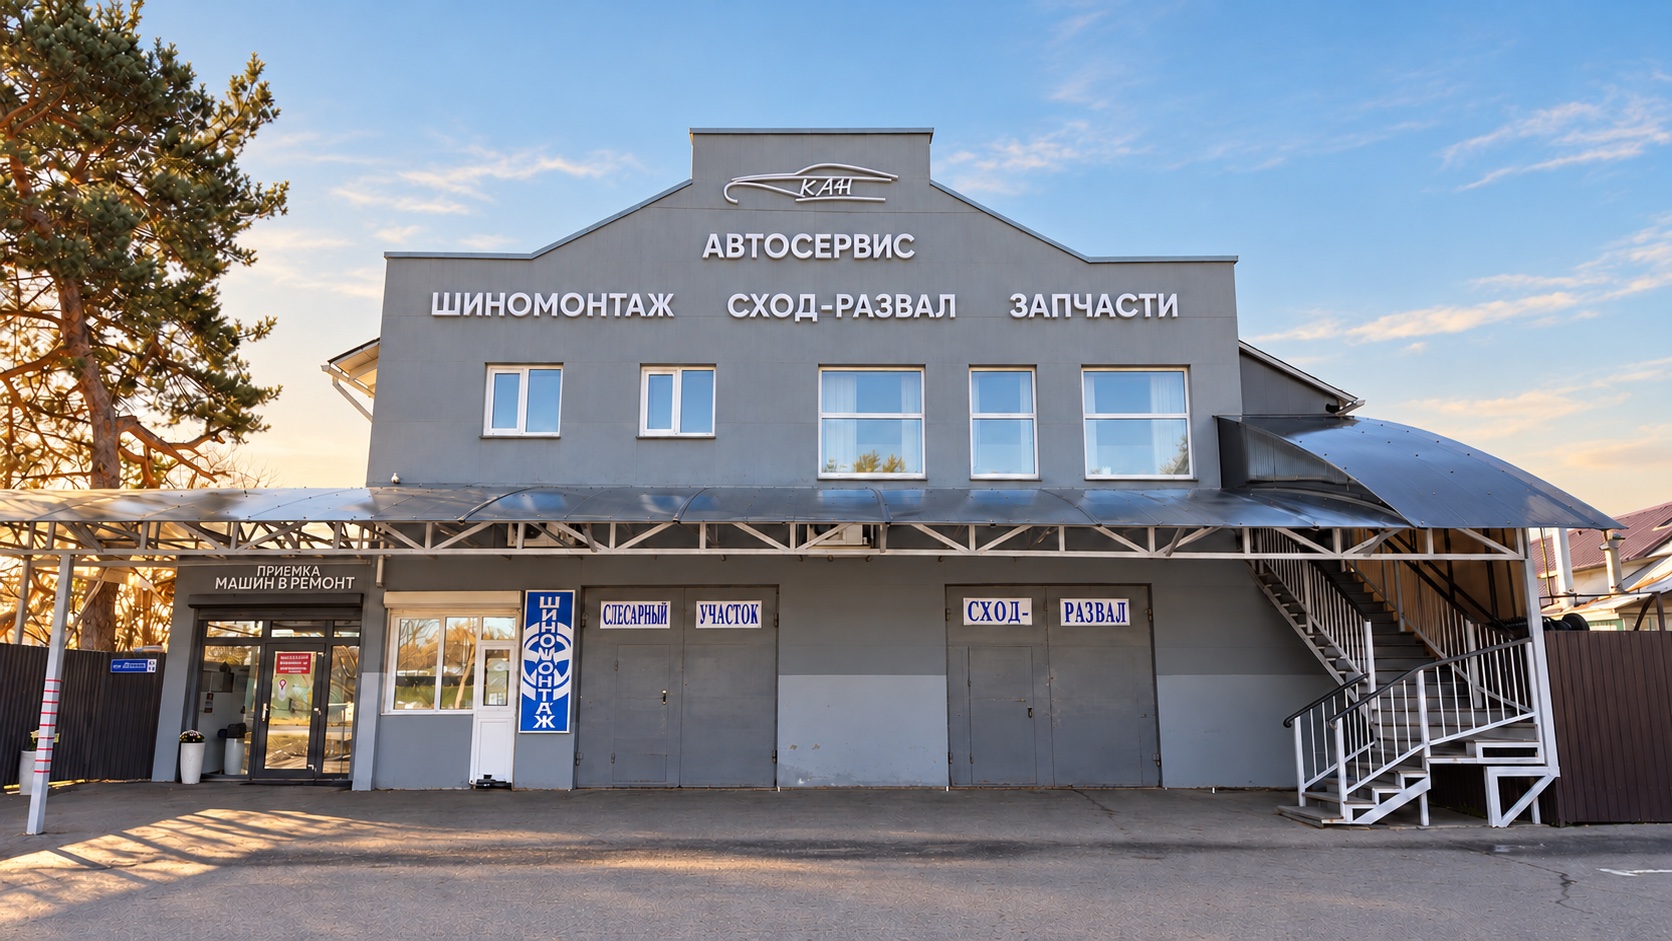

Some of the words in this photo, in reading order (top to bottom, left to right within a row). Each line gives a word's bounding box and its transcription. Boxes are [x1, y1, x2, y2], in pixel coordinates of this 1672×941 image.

[702, 232, 916, 260] АВТОСЕРВИС
[430, 291, 676, 318] ШИНОМОНТАЖ
[727, 292, 957, 322] СХОД-РАЗВАЛ
[1009, 292, 1179, 319] ЗАПЧАСТИ
[215, 577, 275, 590] МАШИН
[278, 577, 288, 590] В
[290, 576, 356, 590] РЕМОНТ
[256, 565, 321, 577] ПРИЕМКА
[603, 602, 668, 625] СЛЕСАРНЫЙ
[699, 603, 759, 625] УЧАСТОК
[967, 600, 1029, 624] СХОД-
[1064, 602, 1127, 623] РАЗВАЛ
